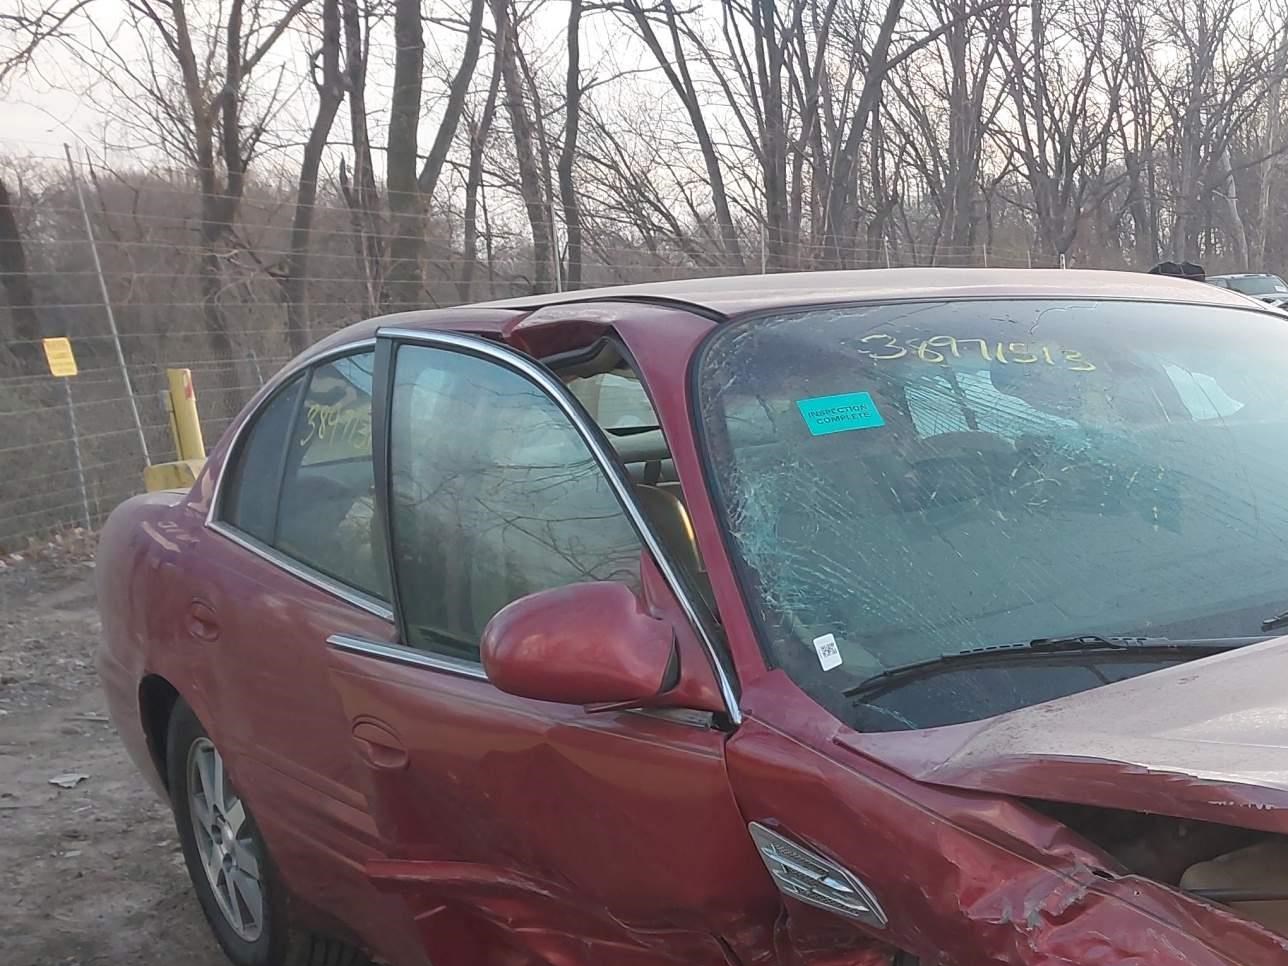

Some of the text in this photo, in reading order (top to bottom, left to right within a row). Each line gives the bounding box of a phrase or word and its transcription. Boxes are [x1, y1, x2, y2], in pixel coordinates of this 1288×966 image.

[857, 334, 1097, 372] 38971513
[807, 404, 869, 418] INSPECTION
[816, 412, 873, 425] COMPLETE
